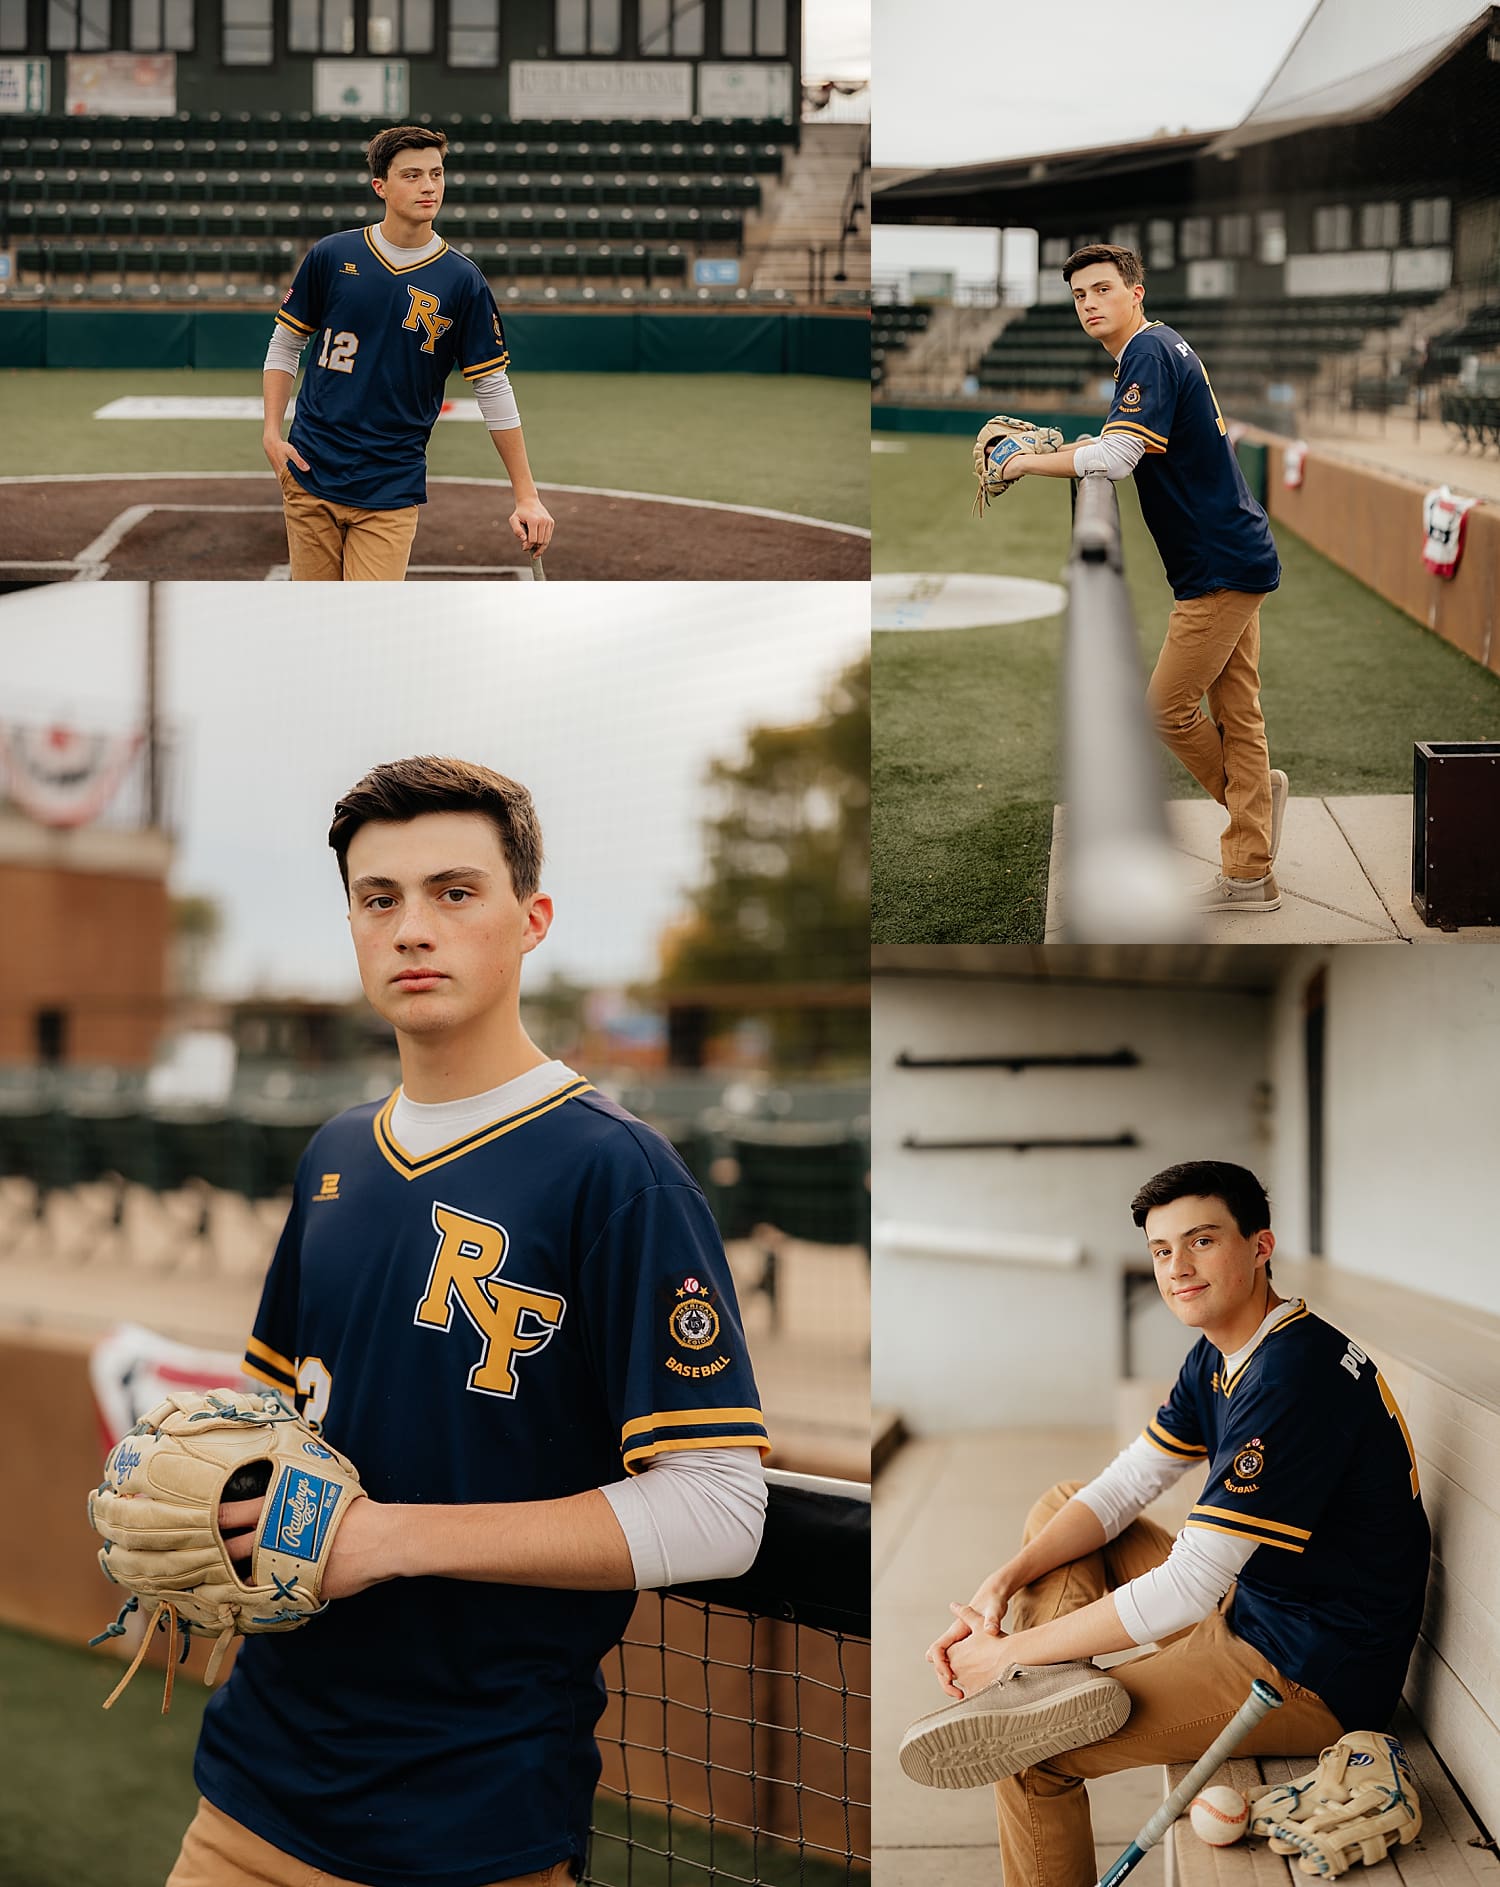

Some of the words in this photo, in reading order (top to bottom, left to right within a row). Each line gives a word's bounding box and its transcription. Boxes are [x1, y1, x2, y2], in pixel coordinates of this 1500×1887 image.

[402, 285, 452, 354] RF
[318, 328, 359, 374] 12
[414, 1201, 566, 1400] RF
[676, 1304, 713, 1320] AMERICAN
[682, 1336, 711, 1345] LEGION
[665, 1355, 731, 1378] BASEBALL
[281, 1477, 317, 1548] Rawlings
